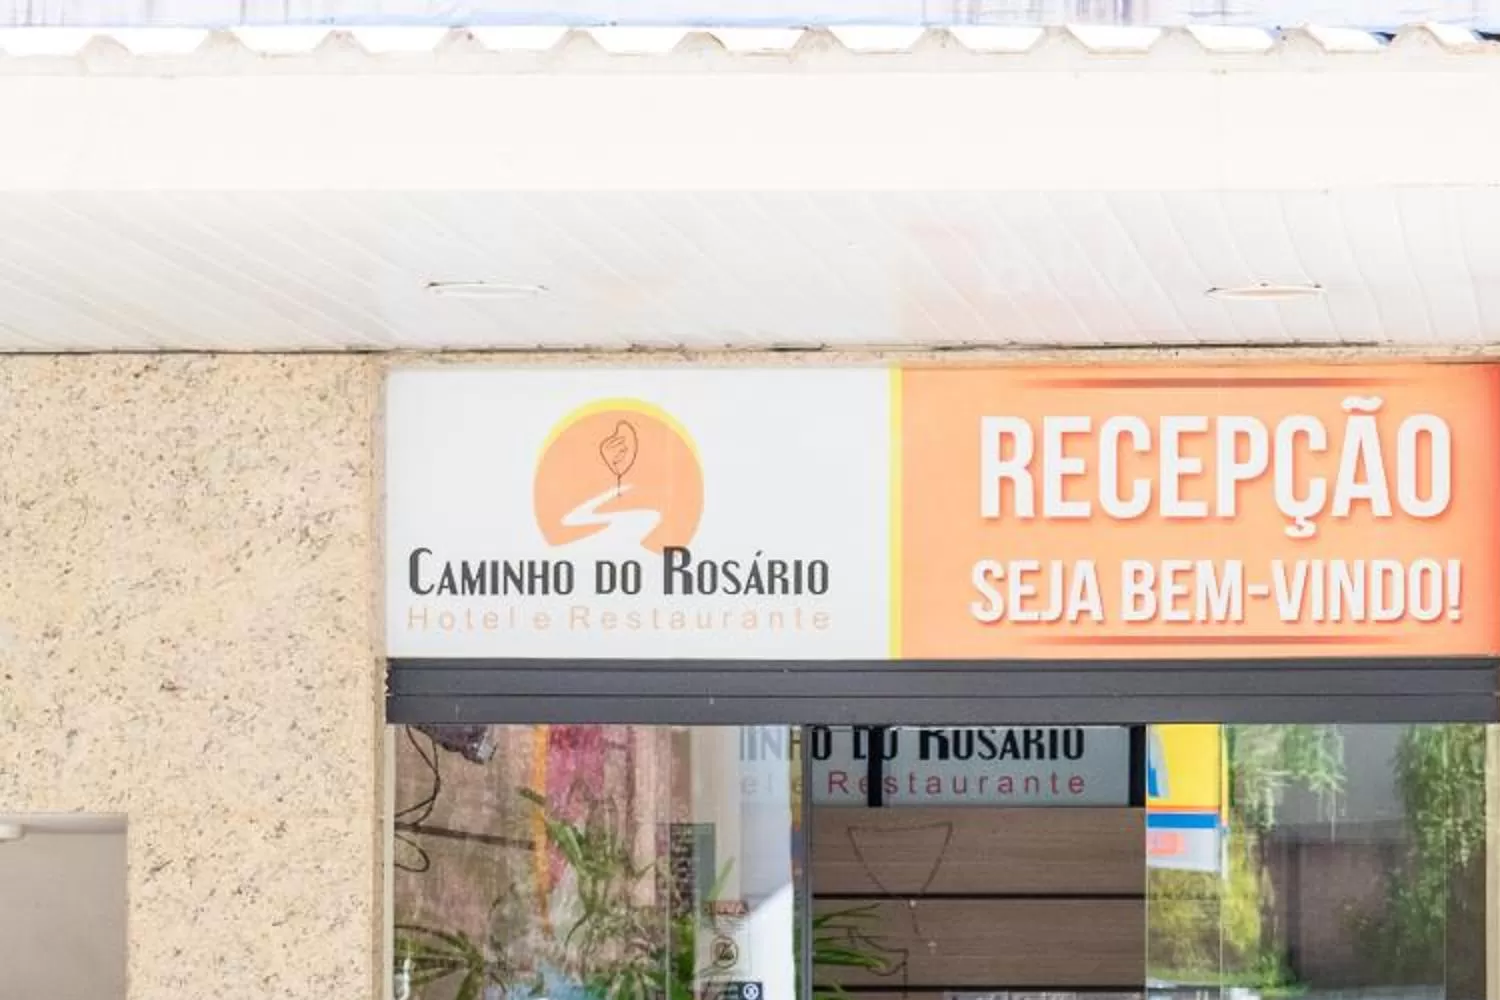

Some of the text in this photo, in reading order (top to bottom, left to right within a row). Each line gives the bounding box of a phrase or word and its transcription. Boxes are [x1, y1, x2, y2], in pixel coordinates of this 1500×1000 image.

[979, 395, 1452, 538] RECEPÇÃO
[408, 545, 830, 597] CAMINHO DO ROSÁRIO
[969, 558, 1462, 623] SEJA BEM-VINDO!
[407, 605, 831, 631] Hotel e Restaurante
[827, 771, 1086, 795] Restaurante
